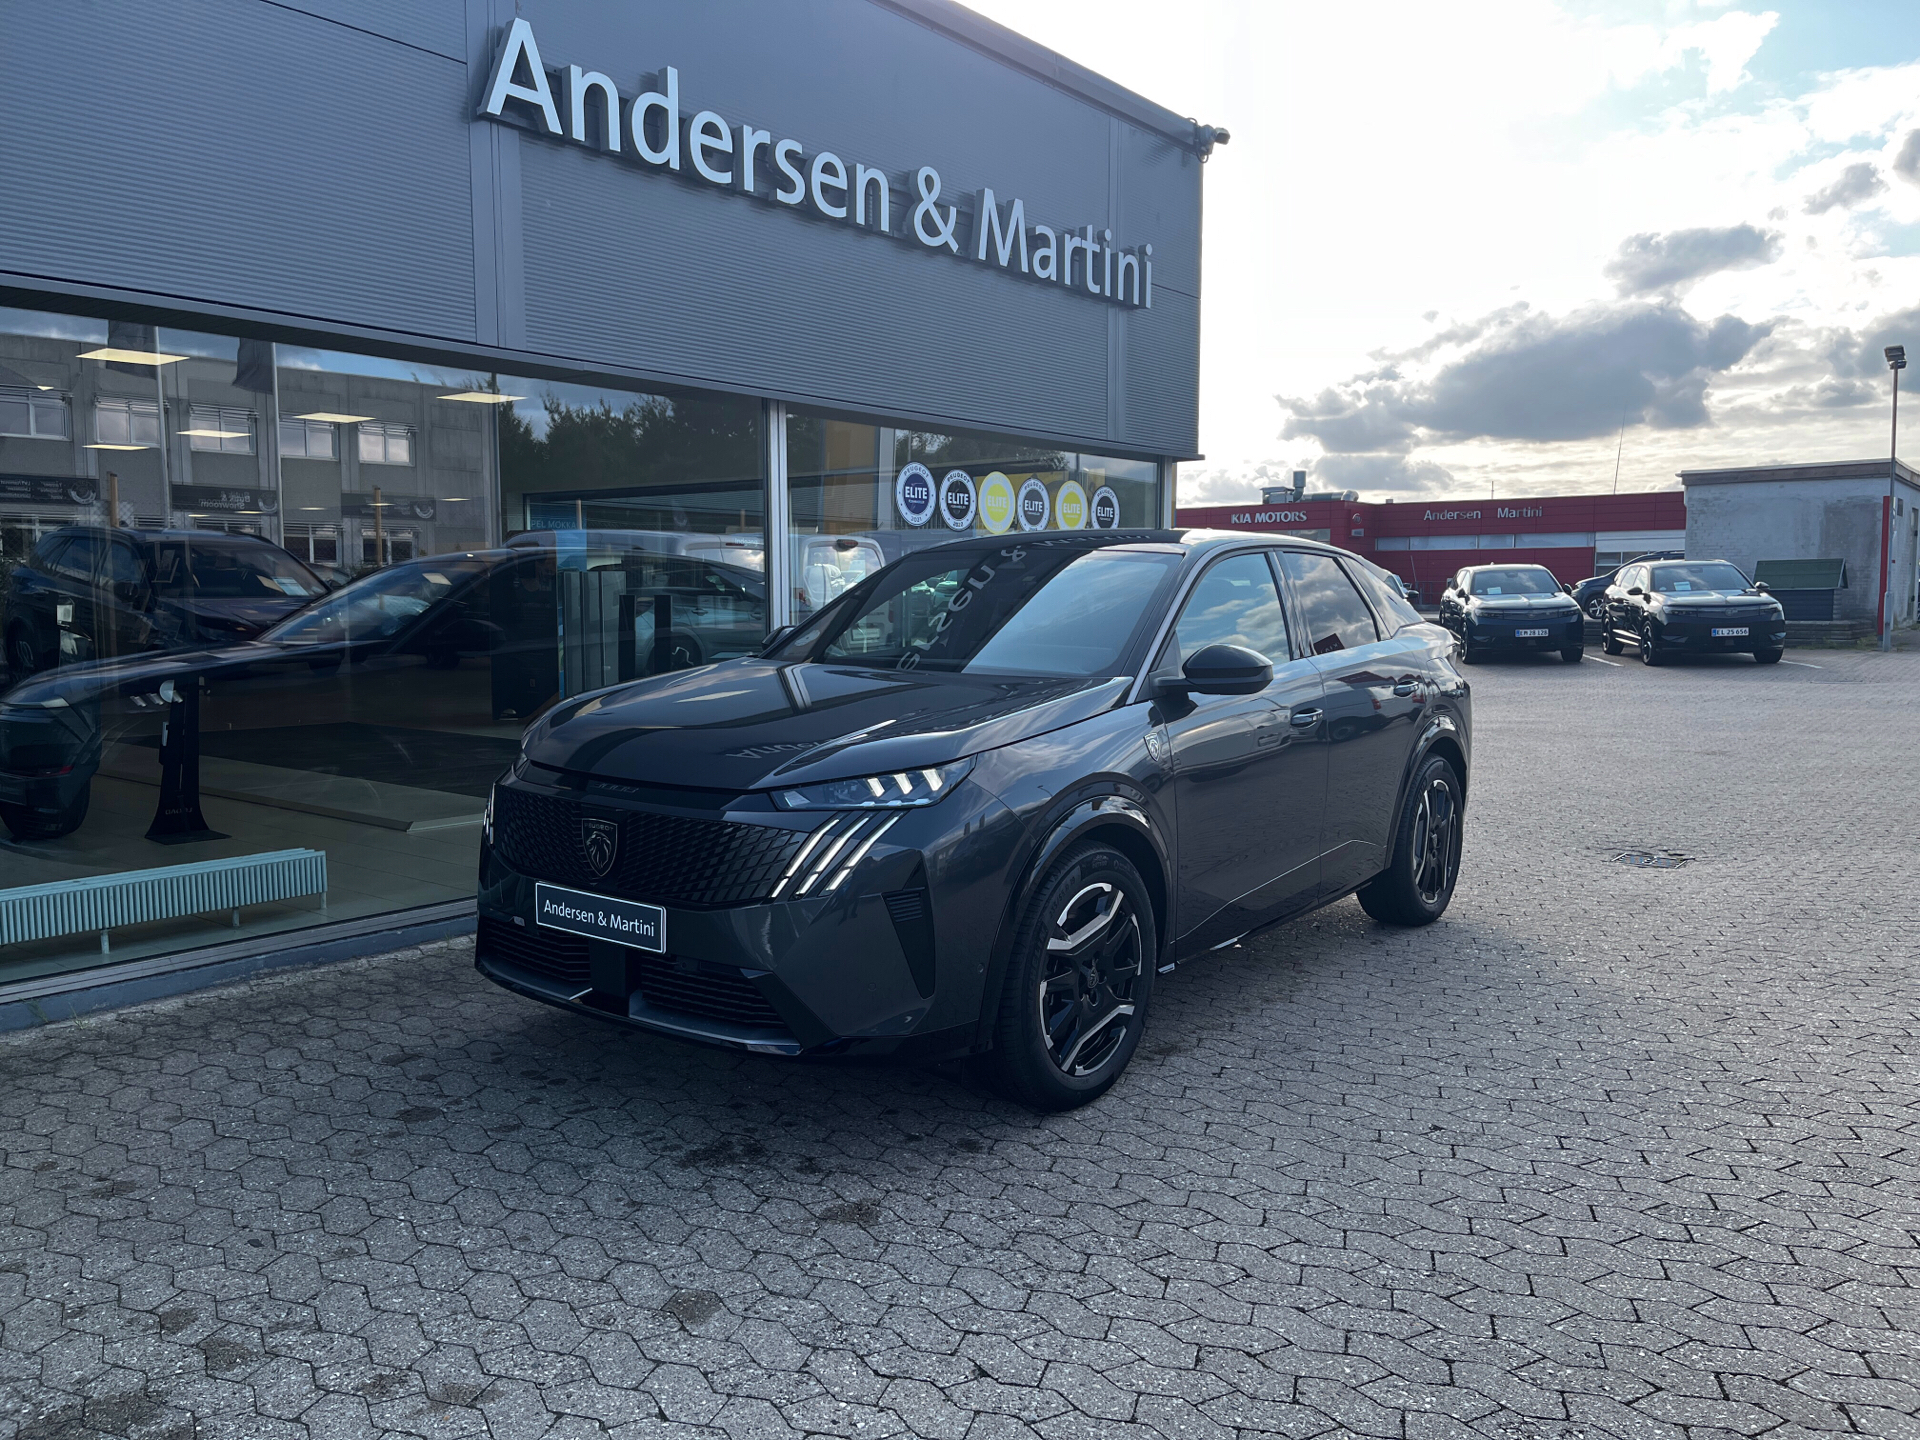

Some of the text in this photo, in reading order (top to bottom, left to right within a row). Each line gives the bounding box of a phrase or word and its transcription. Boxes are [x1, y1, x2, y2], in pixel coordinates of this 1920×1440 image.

[484, 17, 1153, 309] Andersen & Martini
[903, 465, 930, 478] PEUGEOT
[947, 472, 971, 484] PEUGEOT
[904, 486, 928, 500] ELITE
[947, 492, 970, 506] ELITE
[987, 495, 1008, 509] ELITE
[1024, 500, 1043, 512] ELITE
[1063, 503, 1081, 515] ELITE
[1097, 506, 1114, 518] ELITE
[1423, 505, 1543, 521] Andersen Martini
[1231, 510, 1308, 524] KIA MOTORS
[548, 520, 577, 529] MOKKA
[583, 822, 614, 831] PEUGEOT
[544, 899, 655, 937] Andersen & Martini
